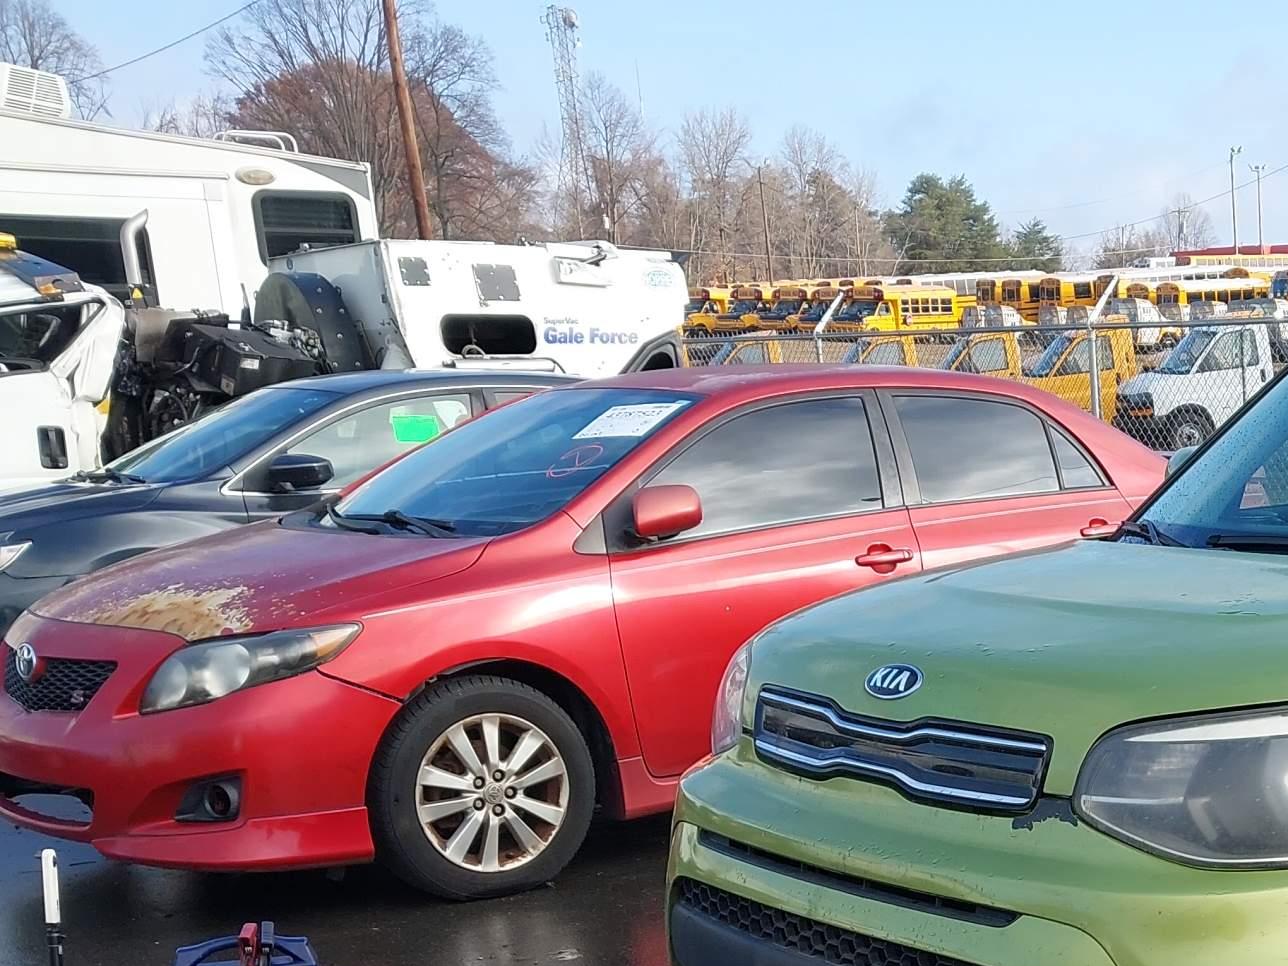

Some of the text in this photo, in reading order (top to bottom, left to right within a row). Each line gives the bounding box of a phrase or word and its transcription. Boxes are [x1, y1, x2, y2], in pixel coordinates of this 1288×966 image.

[543, 326, 639, 345] Gale Force
[869, 666, 912, 692] KIA
